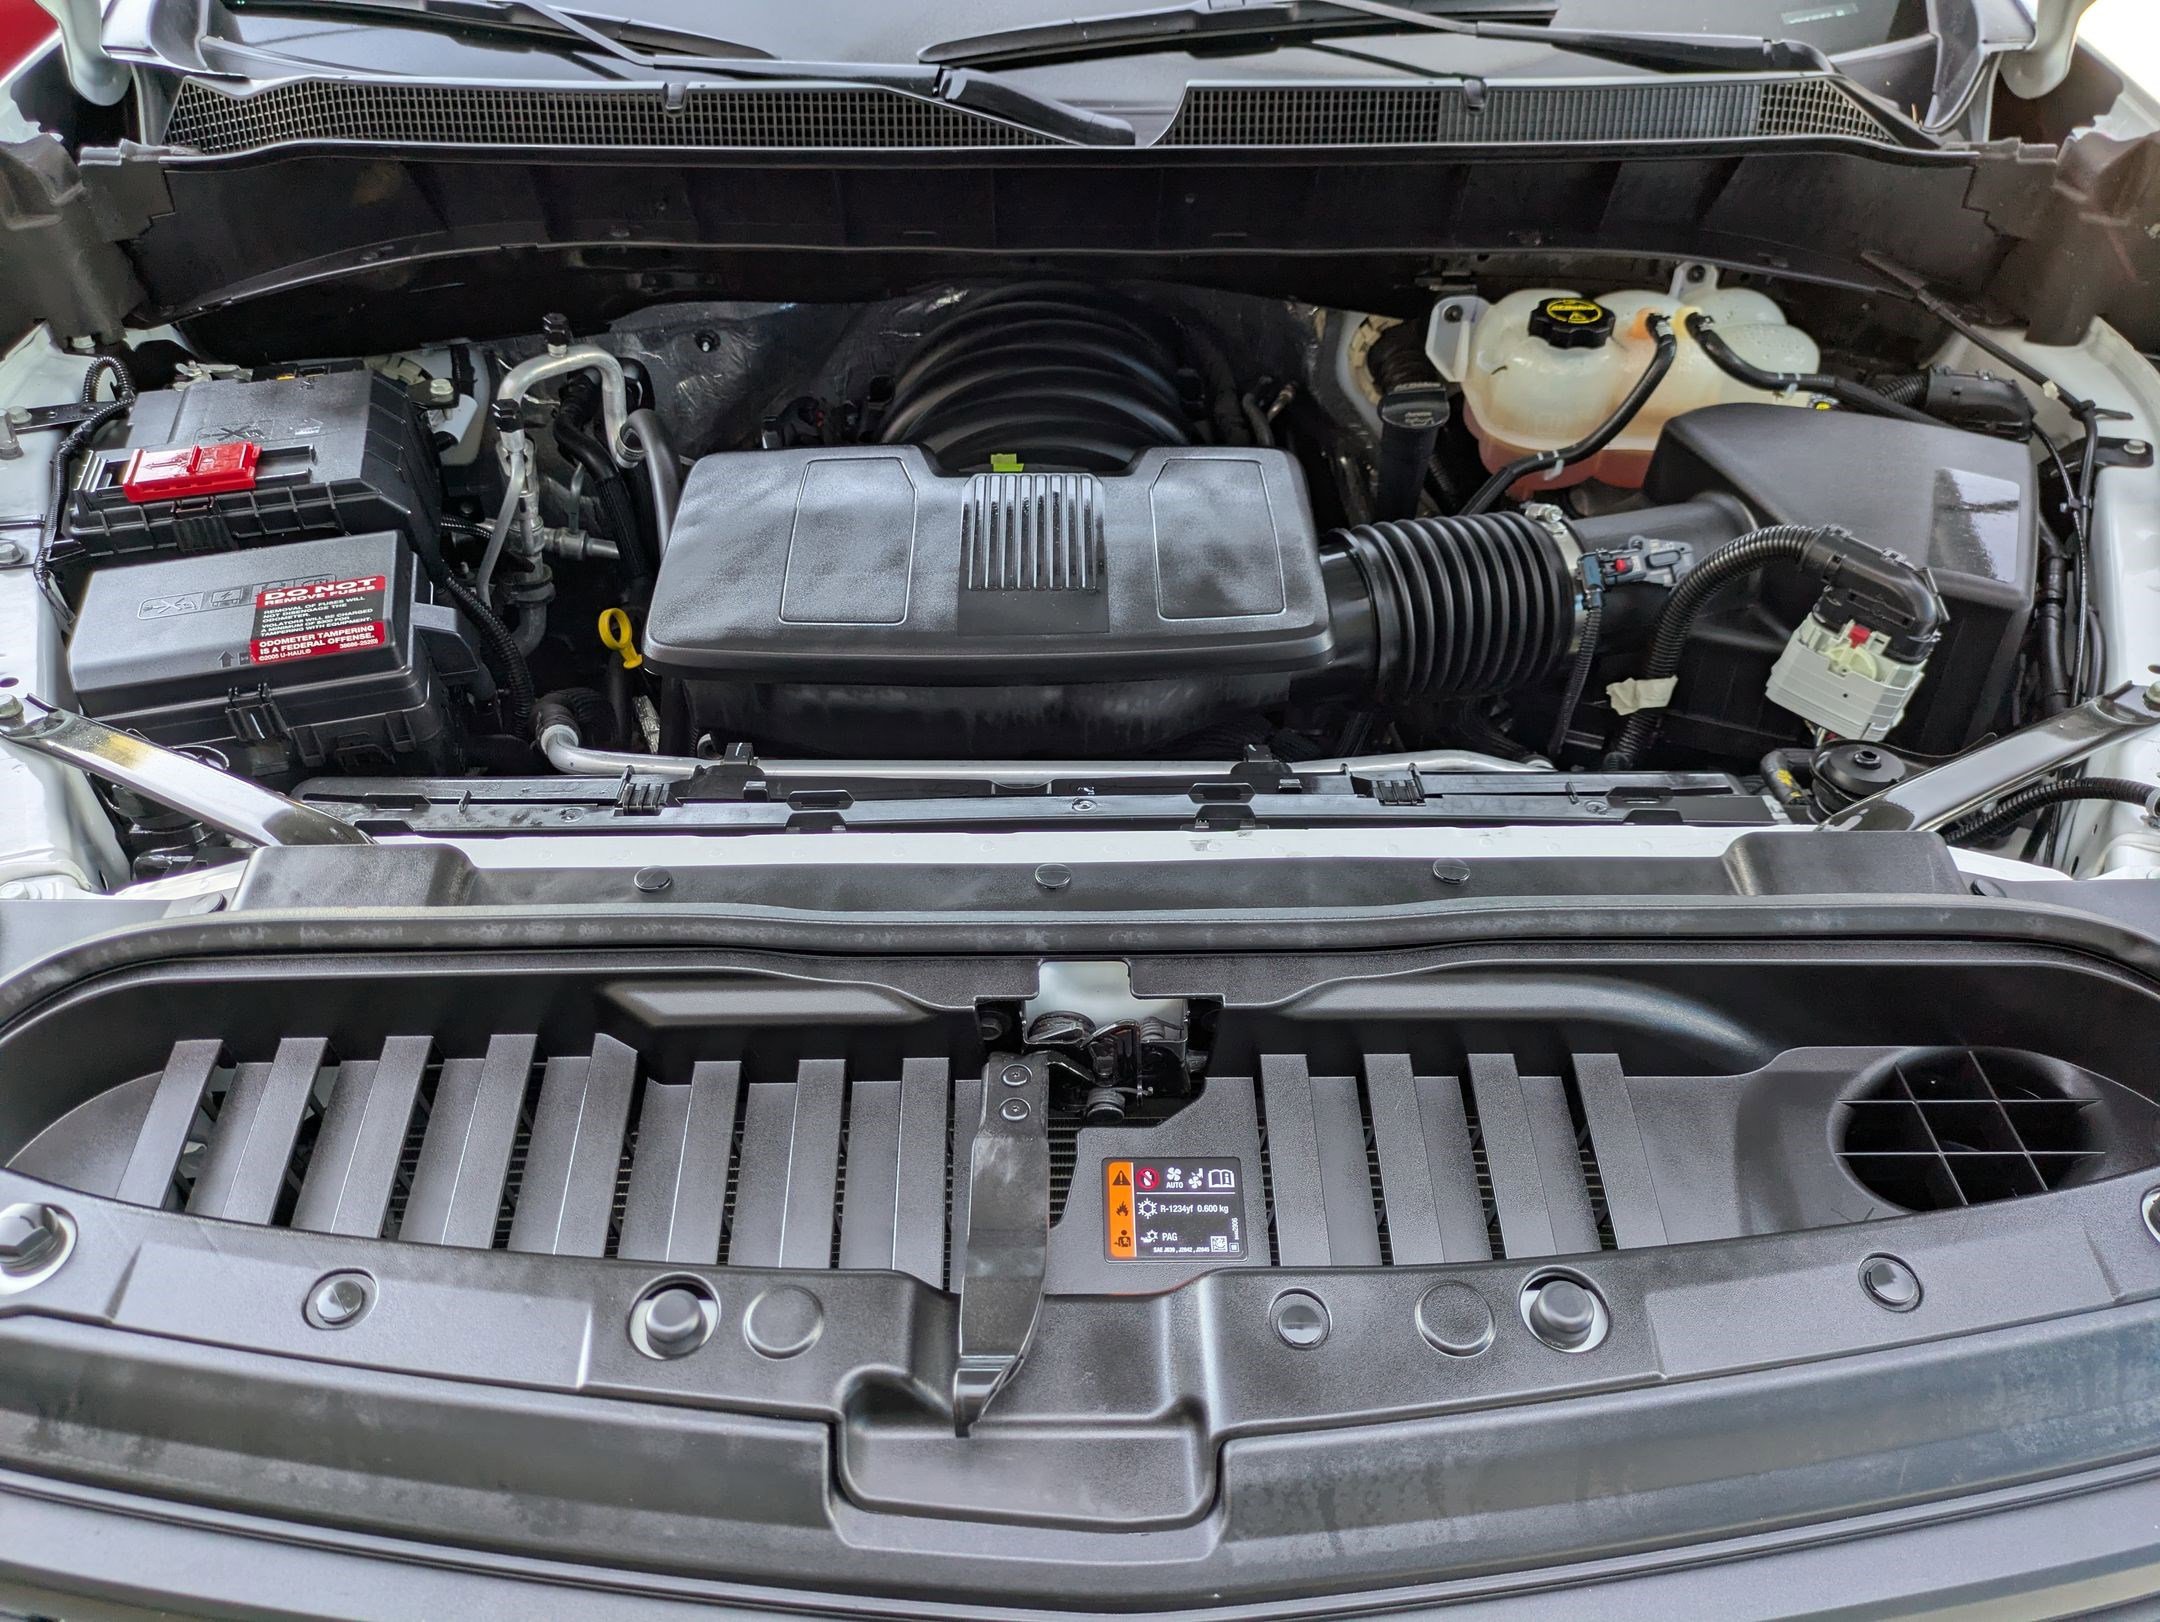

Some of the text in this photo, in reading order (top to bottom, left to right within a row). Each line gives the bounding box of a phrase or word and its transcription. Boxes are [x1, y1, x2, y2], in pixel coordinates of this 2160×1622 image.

[264, 578, 377, 600] DO NOT
[264, 586, 375, 606] REMOVE FUSES
[264, 606, 303, 615] REMOVAL
[336, 608, 373, 617] CHARGED
[259, 625, 375, 647] ODOMETER TAMPERING
[261, 627, 304, 637] TAMPERING
[260, 647, 270, 655] IS
[281, 640, 326, 652] FEDERAL
[328, 633, 375, 644] OFFENSE.
[1160, 1204, 1229, 1214] R-1234yf 0.600 kg
[1162, 1232, 1178, 1241] PAG
